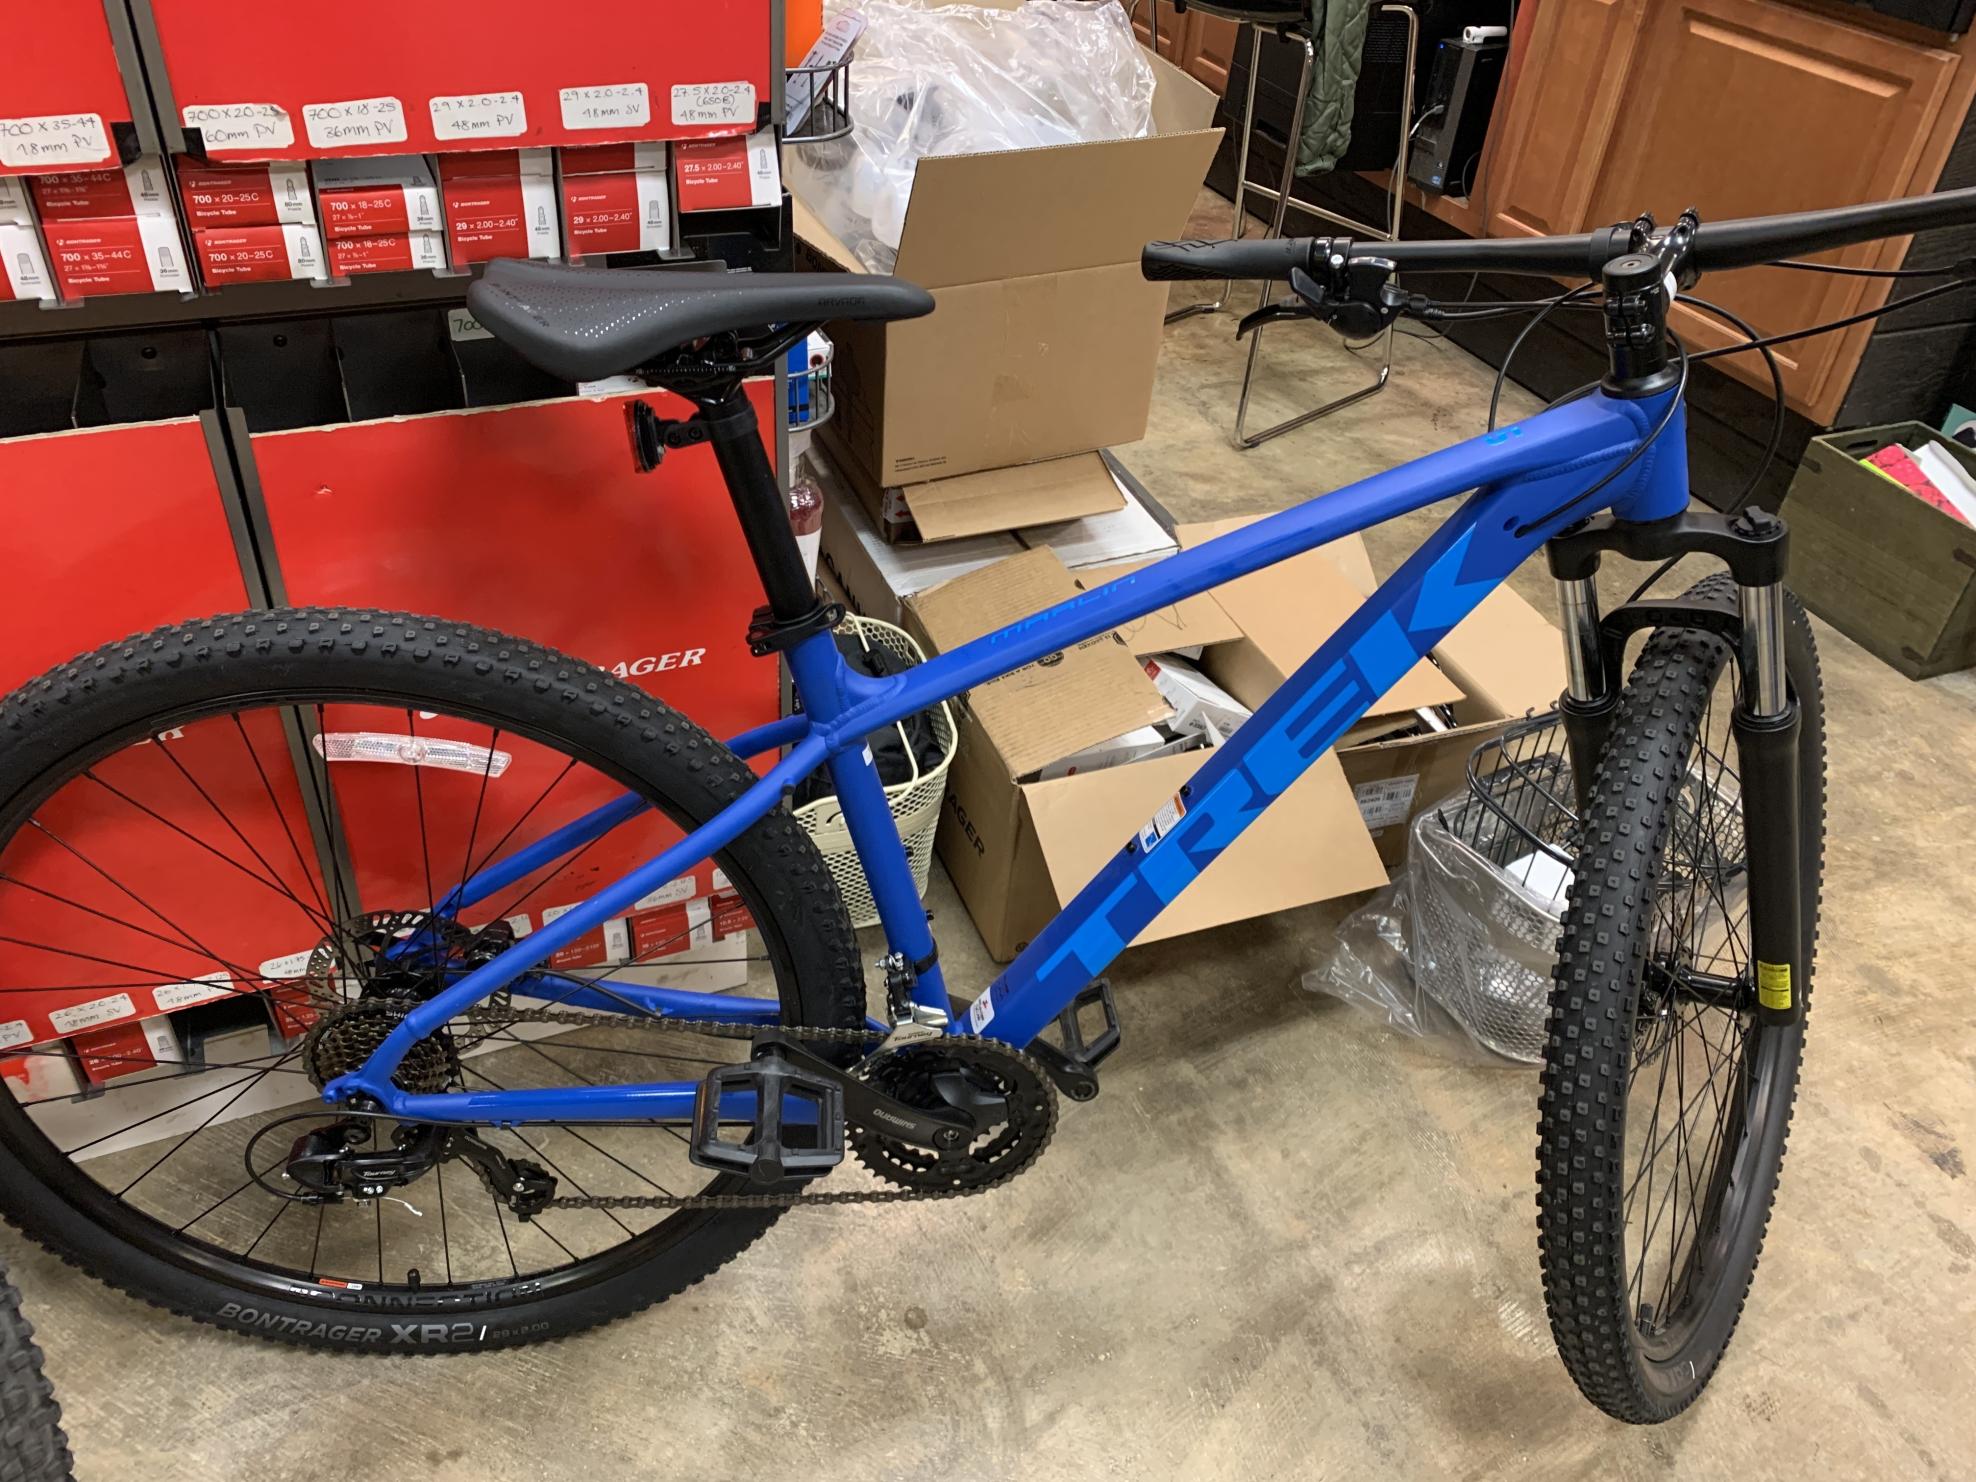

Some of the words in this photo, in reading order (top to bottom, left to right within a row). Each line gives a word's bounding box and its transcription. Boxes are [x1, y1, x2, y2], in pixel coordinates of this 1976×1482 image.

[684, 163, 700, 173] 27.5
[193, 194, 212, 204] 700
[330, 201, 349, 211] 700
[573, 215, 584, 225] 29
[455, 222, 468, 231] 29
[335, 241, 354, 250] 700
[60, 252, 81, 263] 700
[208, 252, 228, 262] 700
[598, 648, 706, 679] AGER
[1035, 520, 1507, 983] TREK
[216, 1302, 383, 1343] BONTRAGER
